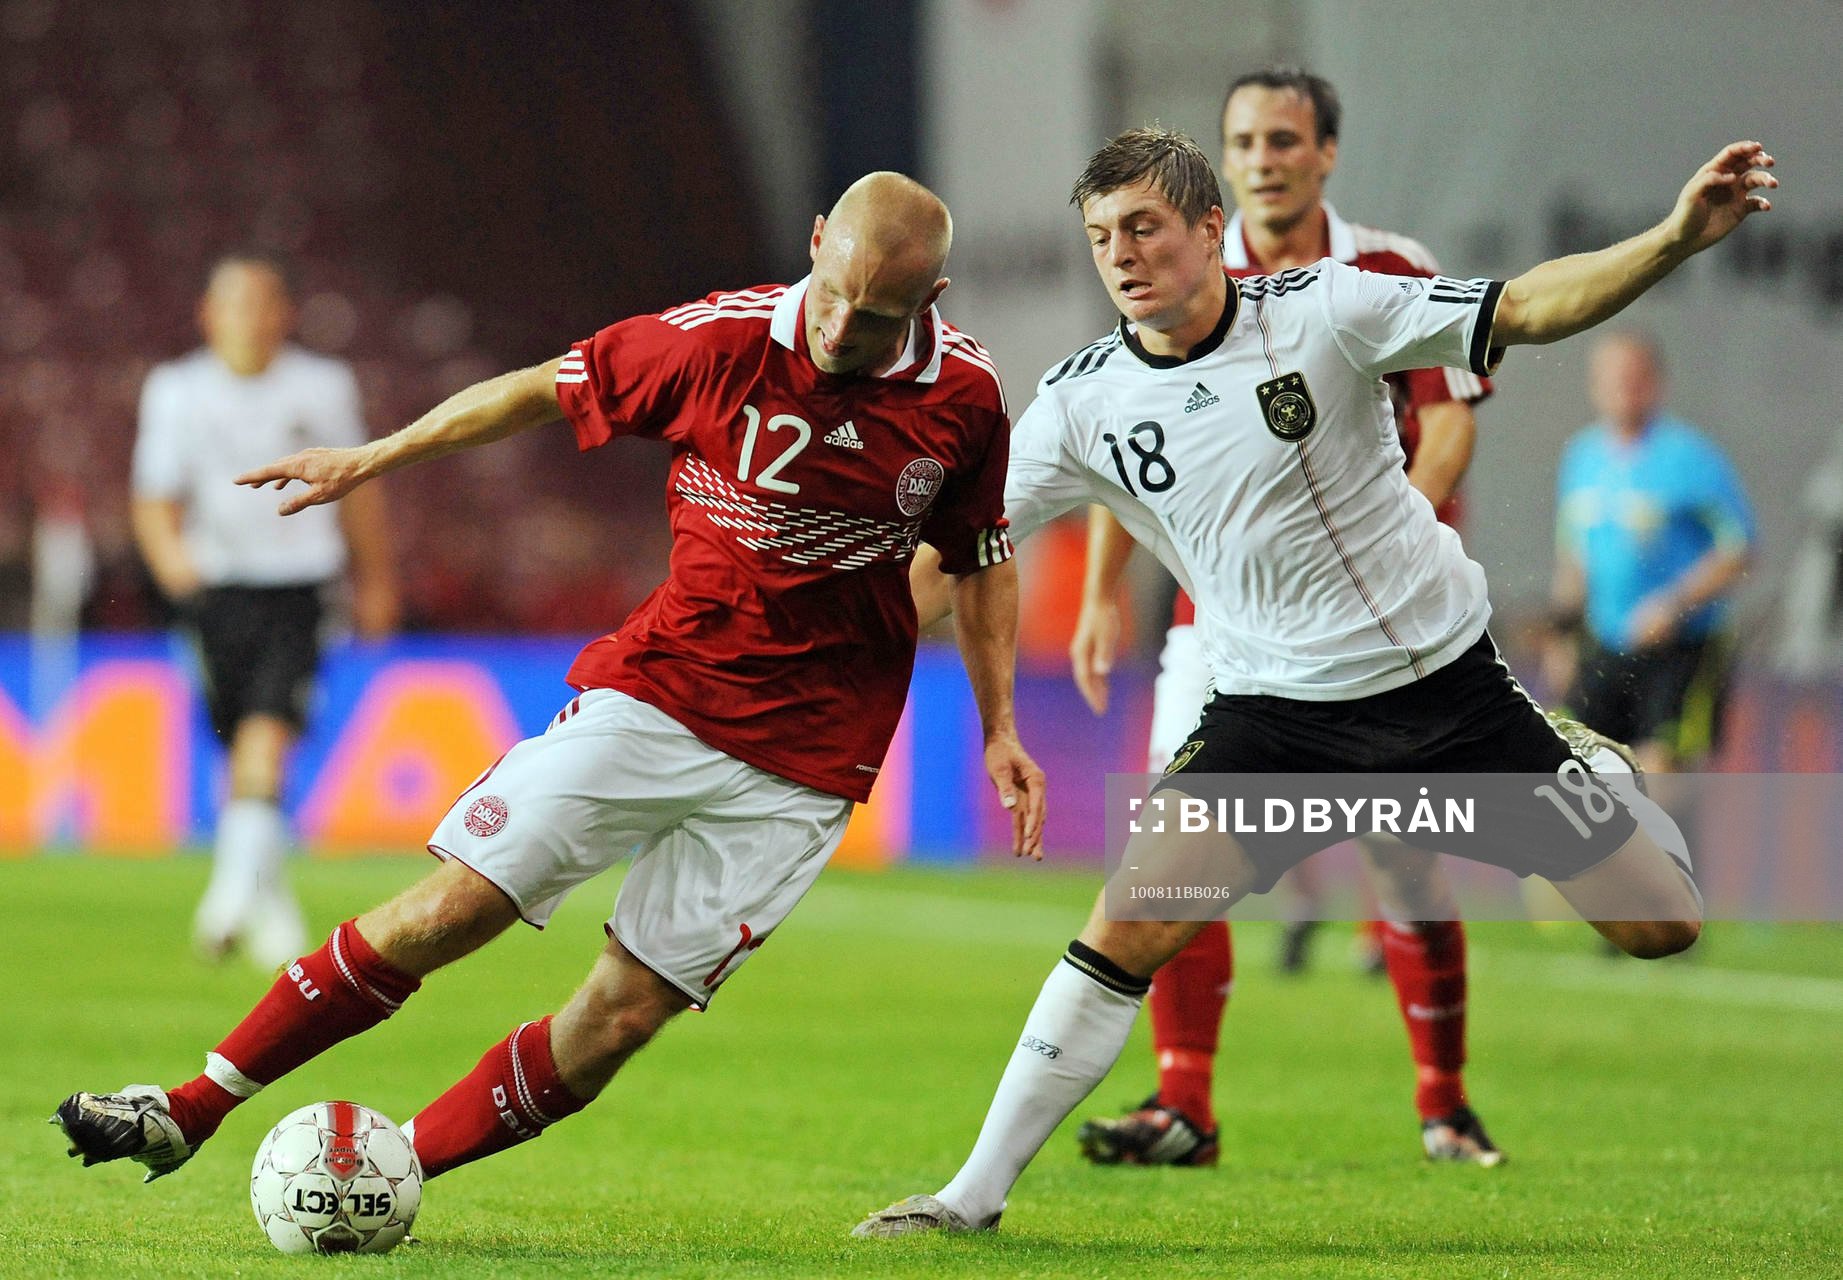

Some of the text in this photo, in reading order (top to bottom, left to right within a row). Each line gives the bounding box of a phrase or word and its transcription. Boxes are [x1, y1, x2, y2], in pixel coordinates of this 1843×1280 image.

[1184, 395, 1220, 414] adidas
[737, 404, 812, 495] 12
[823, 435, 864, 450] adidas
[1103, 420, 1176, 498] 18
[907, 477, 934, 496] DBU
[473, 804, 501, 826] DBU
[1533, 759, 1615, 839] 18
[703, 922, 765, 987] 1
[287, 960, 321, 1001] BU
[292, 1188, 391, 1217] SELECT
